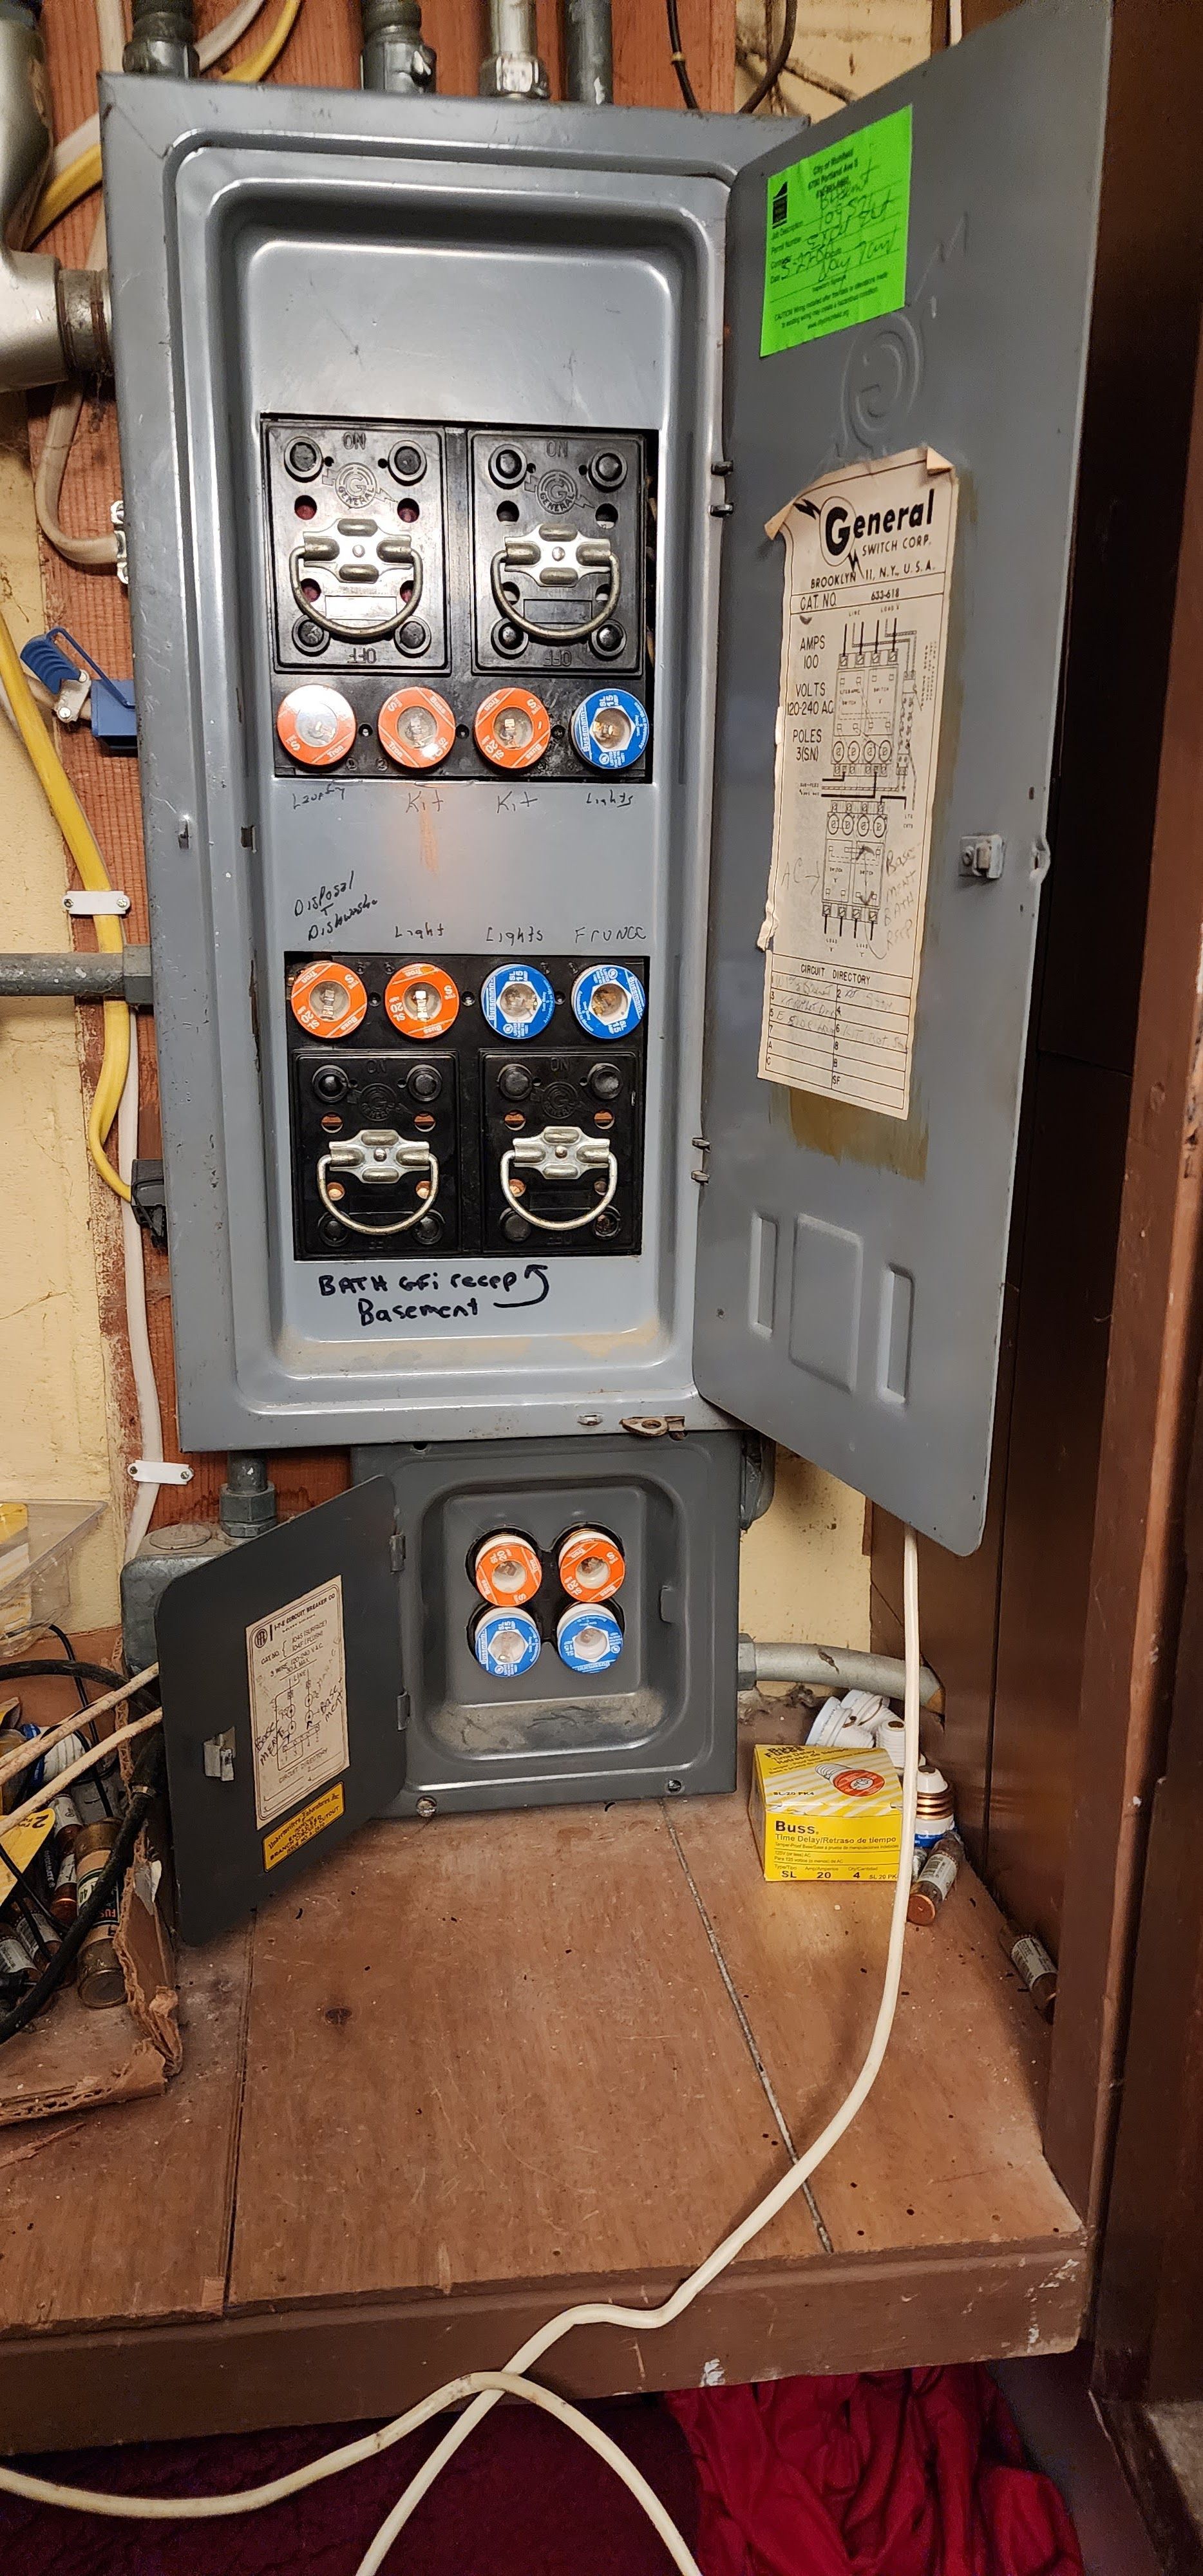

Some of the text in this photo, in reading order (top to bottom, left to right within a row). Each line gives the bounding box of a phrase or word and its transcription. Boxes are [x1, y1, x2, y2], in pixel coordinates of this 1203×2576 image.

[343, 432, 366, 450] ON
[546, 441, 568, 459] ON
[337, 486, 375, 506] GENERAL
[540, 492, 576, 512] GENERAL
[824, 489, 934, 556] General
[862, 541, 898, 556] SWITCH
[811, 572, 857, 589] BROOKLYN
[800, 635, 826, 652] AMPS
[804, 654, 819, 669] 100
[795, 682, 826, 697] VOLTS
[430, 696, 447, 714] Buss
[484, 697, 501, 712] Tron
[822, 700, 834, 714] AC
[580, 711, 590, 752] Bussmann
[793, 728, 822, 744] POLES
[327, 744, 344, 759] Tron
[389, 741, 404, 758] Tron
[526, 743, 543, 760] Buss
[405, 790, 444, 814] Kit
[497, 791, 538, 815] Kit
[585, 789, 634, 808] Lights
[395, 922, 444, 940] Light
[486, 926, 544, 947] Lights
[301, 969, 318, 984] Tron
[404, 967, 422, 977] Tron
[801, 964, 871, 984] CIRCUIT DIRECTORY
[390, 1002, 404, 1012] 20
[340, 1016, 358, 1030] Buss
[422, 1025, 442, 1034] Buss
[318, 1274, 388, 1297] BATH
[357, 1297, 478, 1327] Basement
[481, 1579, 491, 1596] Buss
[599, 1585, 616, 1598] Buss
[286, 1608, 305, 1624] CIRCUIT
[307, 1597, 328, 1613] BREAKER
[294, 1669, 307, 1681] LINE
[279, 1766, 299, 1784] CIRCUIT
[301, 1748, 328, 1770] DIRECTORY
[775, 1821, 815, 1834] Buss
[775, 1833, 795, 1842] Time
[797, 1835, 855, 1845] Delay/Retraso
